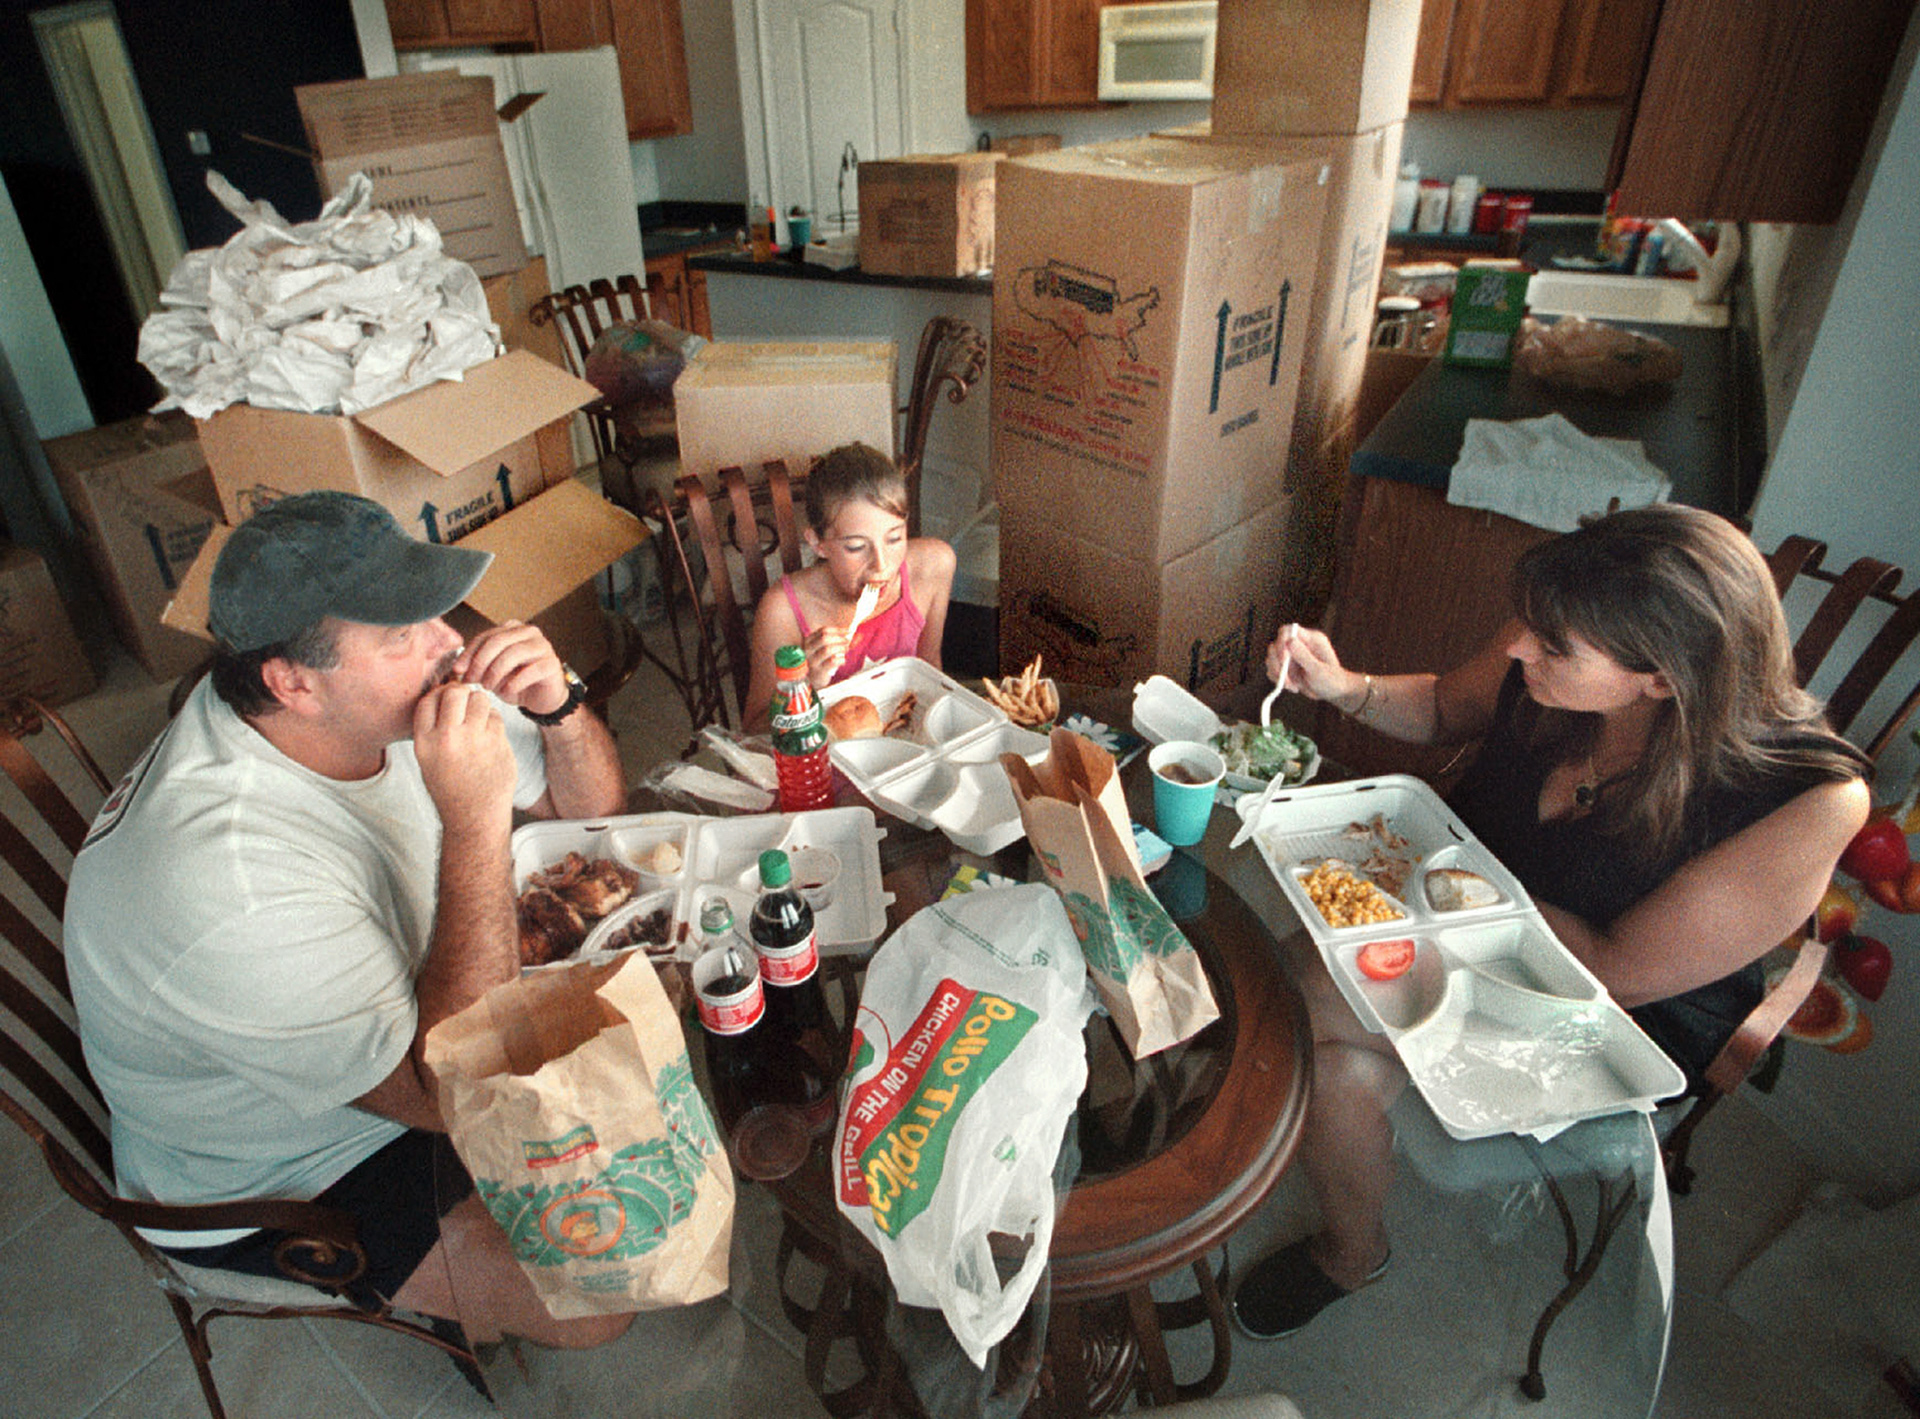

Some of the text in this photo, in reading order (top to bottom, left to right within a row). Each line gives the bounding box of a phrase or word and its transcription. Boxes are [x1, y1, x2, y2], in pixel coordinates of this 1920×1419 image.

[445, 490, 496, 526] FRAGILE
[843, 992, 961, 1191] CHICKEN ON THE GRILL
